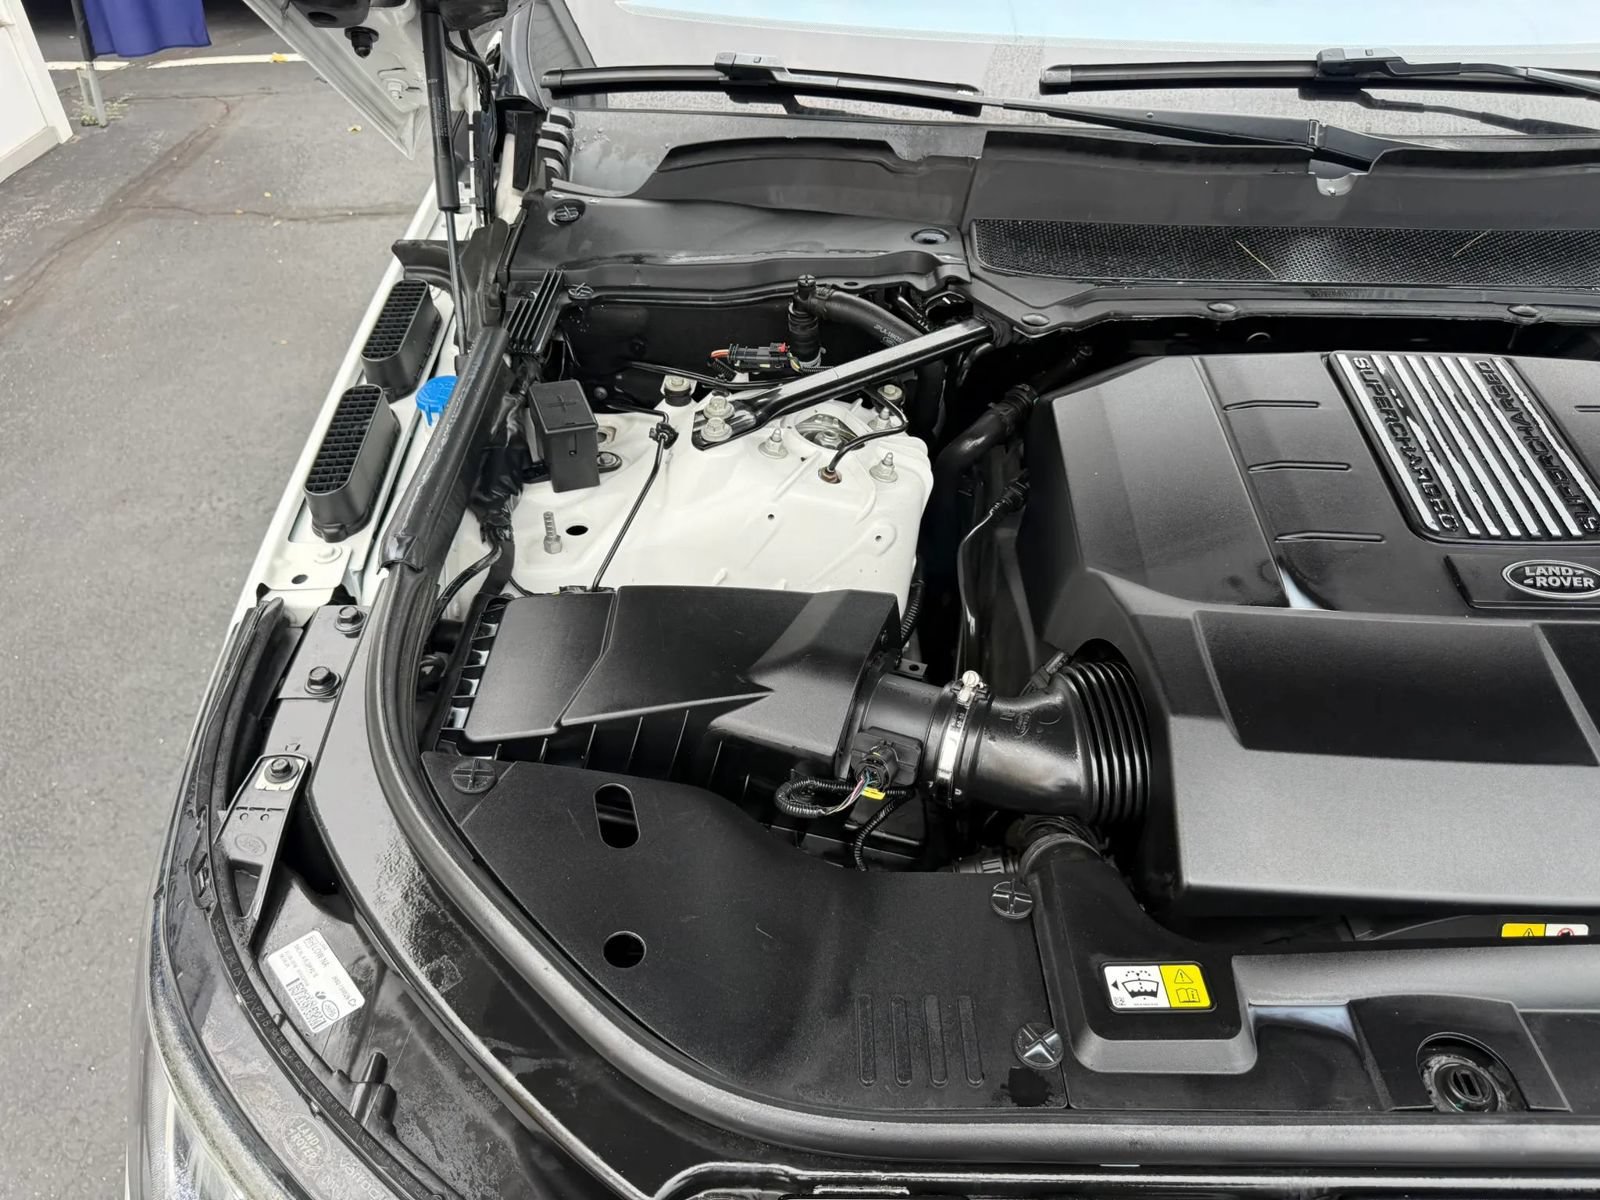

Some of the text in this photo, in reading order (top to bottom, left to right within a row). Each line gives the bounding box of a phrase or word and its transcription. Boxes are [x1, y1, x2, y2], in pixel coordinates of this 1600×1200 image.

[1352, 356, 1460, 533] SUPERCHARGED
[1474, 359, 1600, 533] SUPERCHARGED
[1524, 565, 1574, 577] LAND
[1535, 576, 1596, 588] ROVER
[290, 1131, 318, 1162] ROVER
[296, 1121, 321, 1148] LAND
